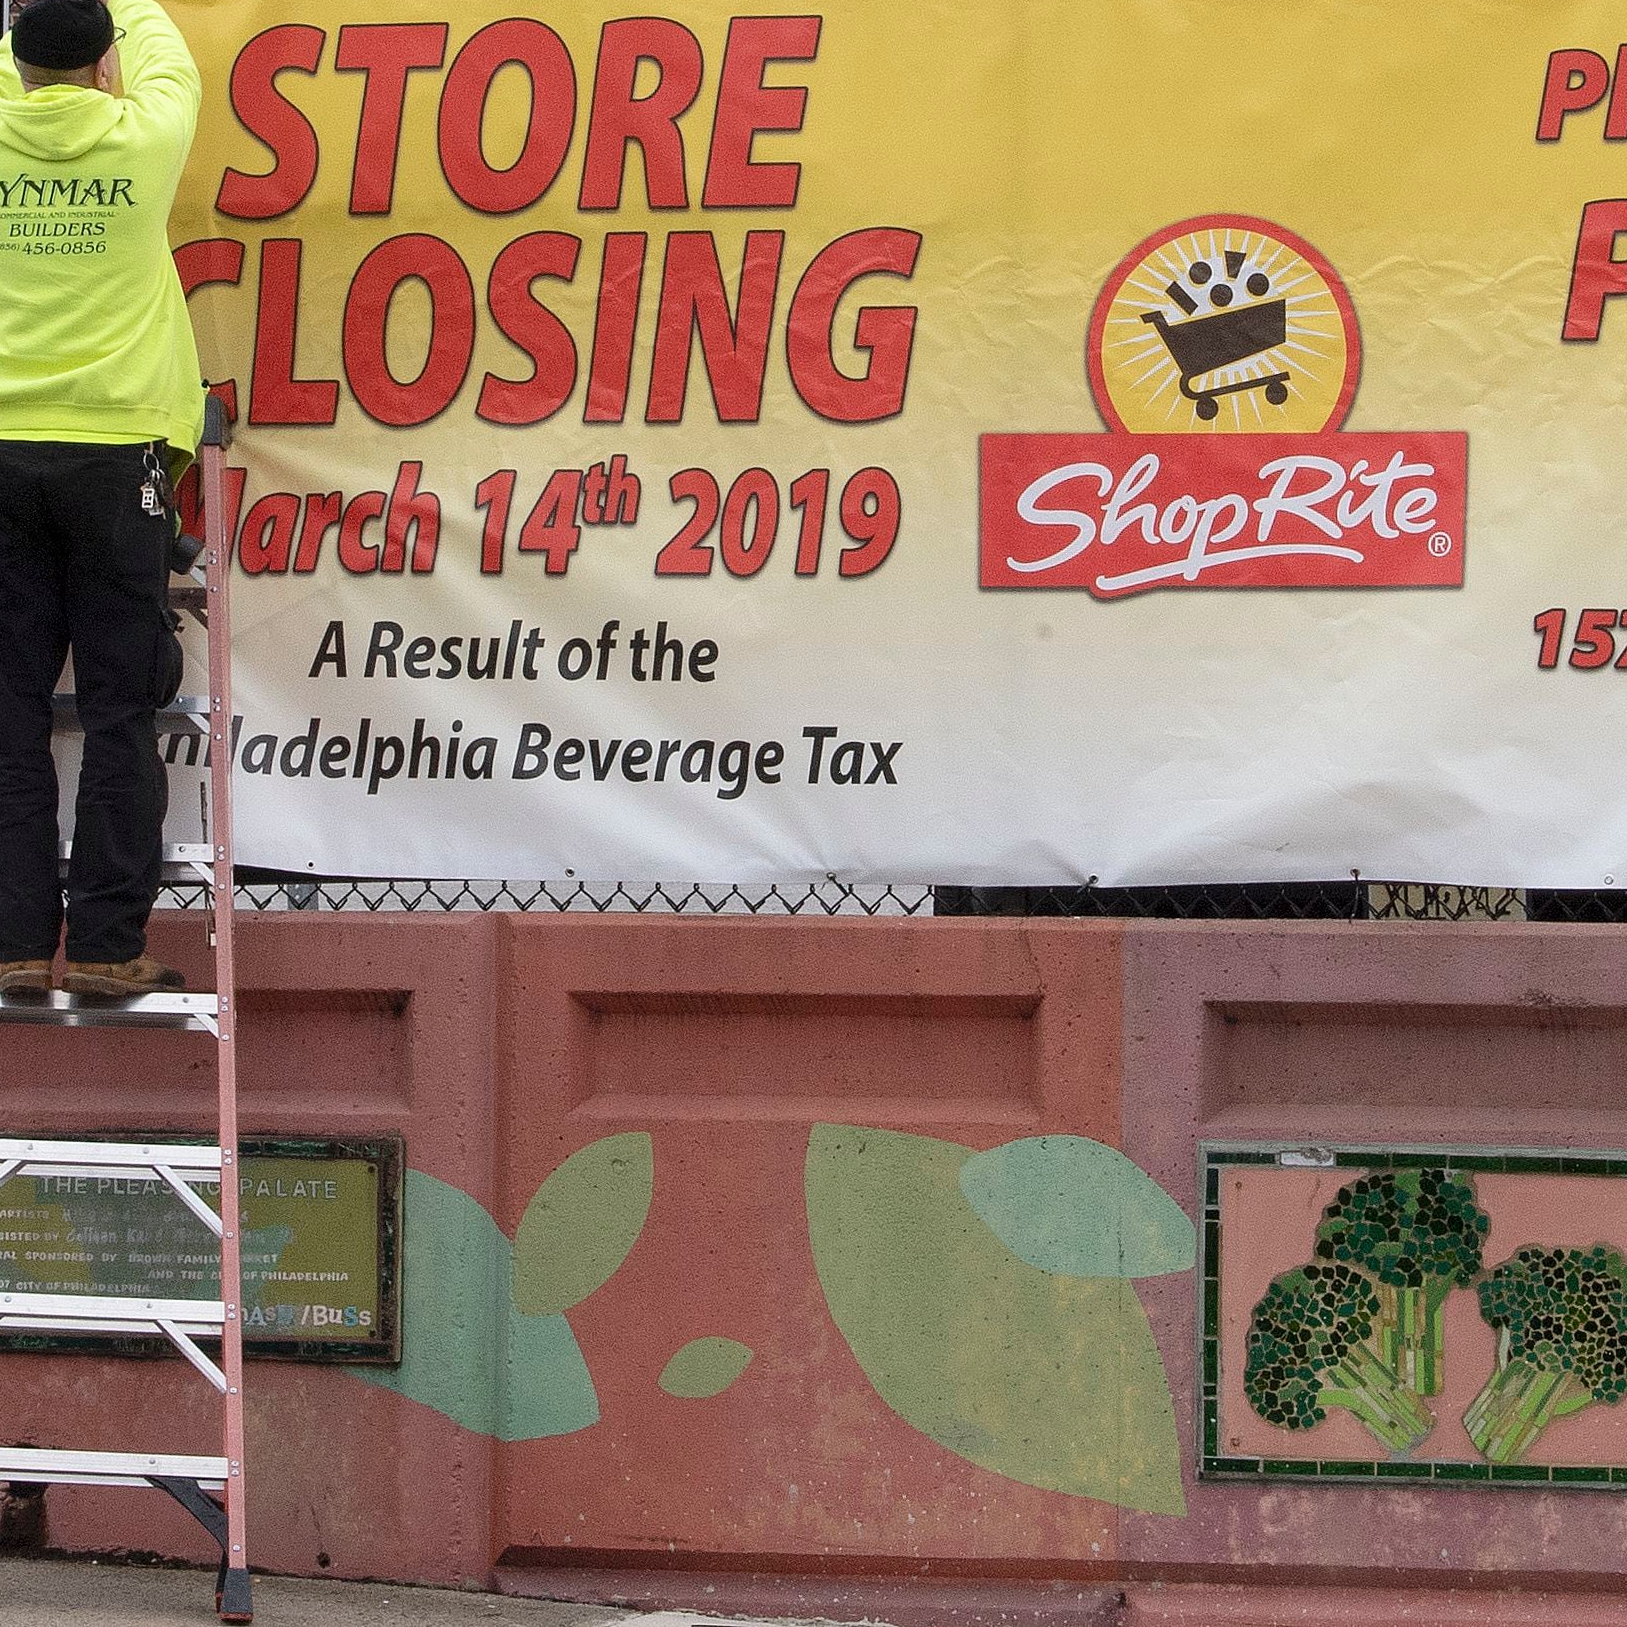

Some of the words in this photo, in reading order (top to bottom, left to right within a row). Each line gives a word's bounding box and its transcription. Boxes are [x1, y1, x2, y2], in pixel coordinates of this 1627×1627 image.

[214, 15, 823, 219] STORE
[10, 222, 106, 237] BUILDERS
[22, 241, 107, 255] 456-0856
[476, 453, 642, 576] 14th
[654, 467, 902, 578] 2019
[309, 619, 345, 679] A
[364, 619, 545, 681] Result
[558, 620, 620, 681] of
[630, 620, 719, 682] the
[165, 717, 498, 794] hladelphia
[511, 722, 783, 800] Beverage
[801, 726, 903, 786] Tax
[41, 1176, 87, 1194] THE
[97, 1177, 220, 1195] PLEASNG
[239, 1179, 337, 1199] PALATE
[44, 1232, 60, 1242] BY
[25, 1251, 94, 1262] SPONSORED
[102, 1253, 118, 1262] BY
[177, 1254, 221, 1264] FAMILY
[148, 1270, 173, 1280] AND
[180, 1271, 203, 1280] THE
[243, 1272, 258, 1280] OF
[261, 1271, 349, 1281] PHILADELPHIA
[16, 1281, 43, 1290] CITY
[46, 1281, 61, 1290] OF
[63, 1281, 150, 1294] PHILADELPHIA
